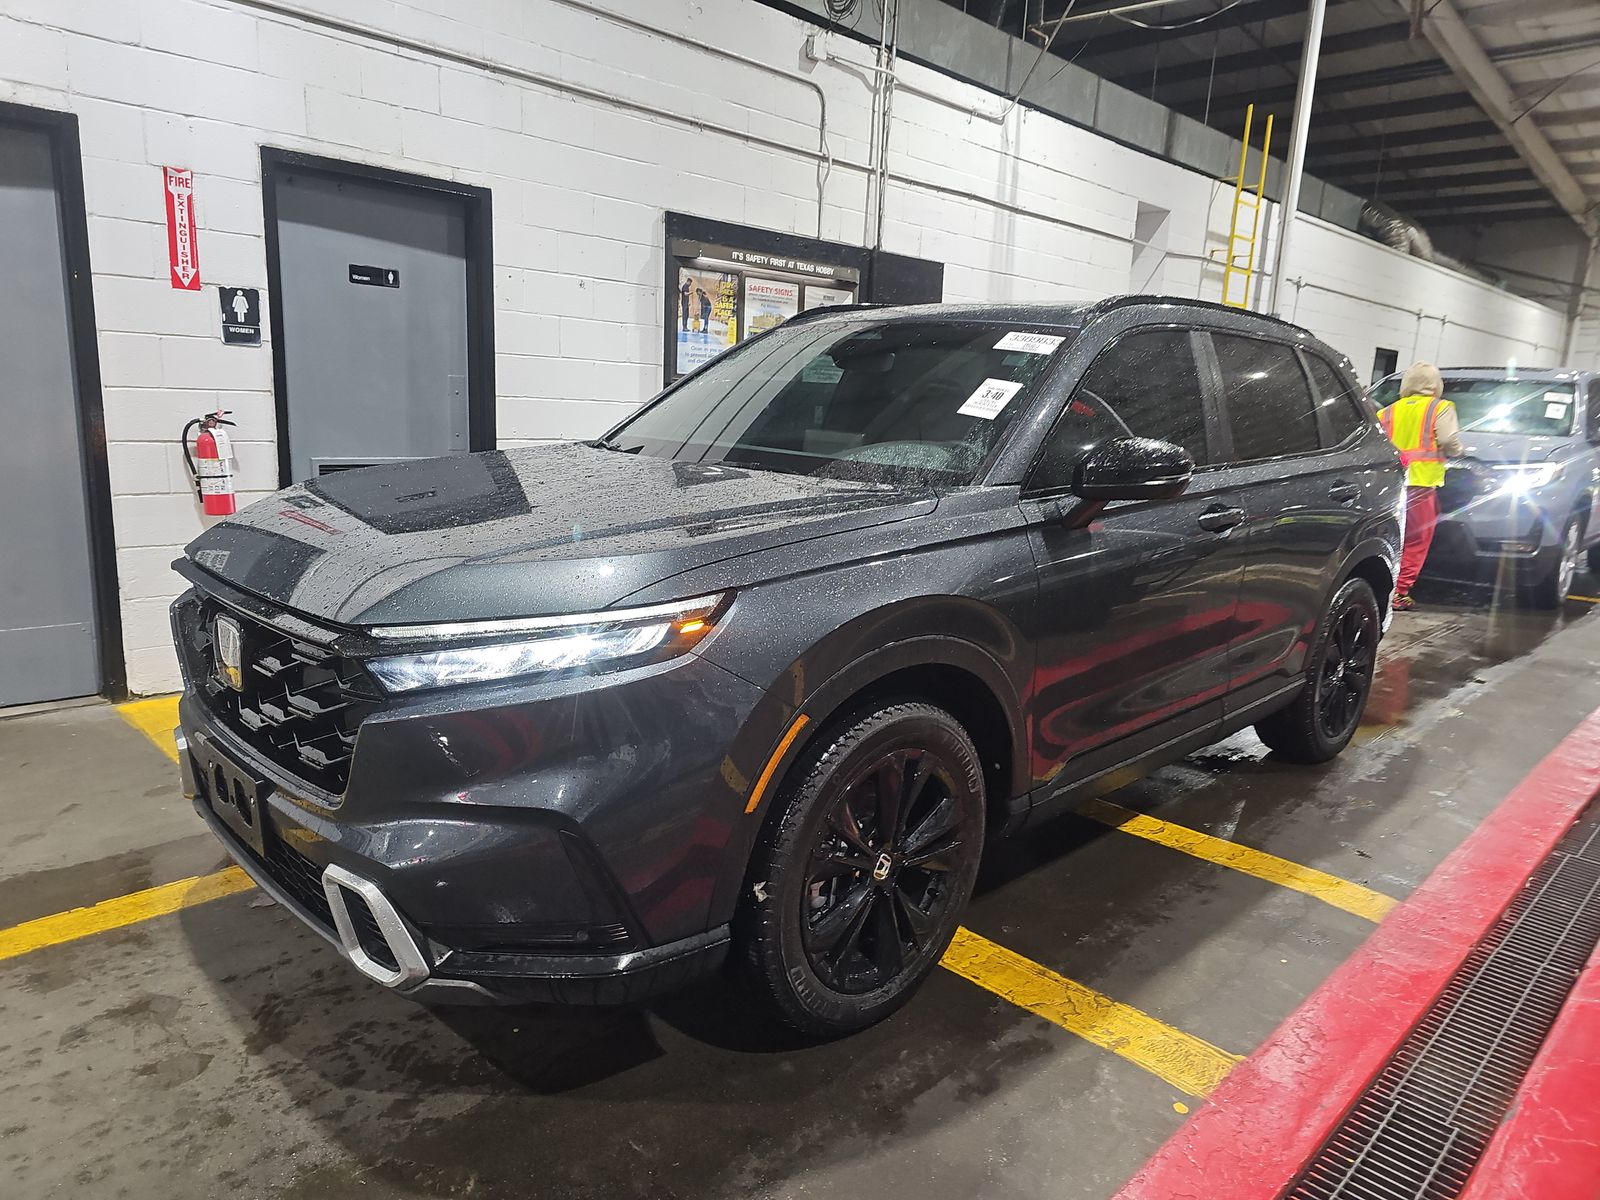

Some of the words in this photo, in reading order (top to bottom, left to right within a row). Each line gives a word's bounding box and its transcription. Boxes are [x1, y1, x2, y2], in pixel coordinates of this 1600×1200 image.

[169, 175, 191, 189] FIRE
[177, 193, 190, 280] EXTINGUISHER
[732, 251, 744, 261] IT'S
[745, 253, 769, 265] SAFETY
[770, 257, 787, 267] FIRST
[787, 260, 795, 269] AT
[796, 262, 815, 273] TEXAS
[815, 266, 835, 276] HOBBY
[748, 284, 774, 294] SAFETY
[774, 287, 793, 297] SIGNS
[229, 326, 255, 335] WOMEN
[981, 389, 1005, 401] 3:40
